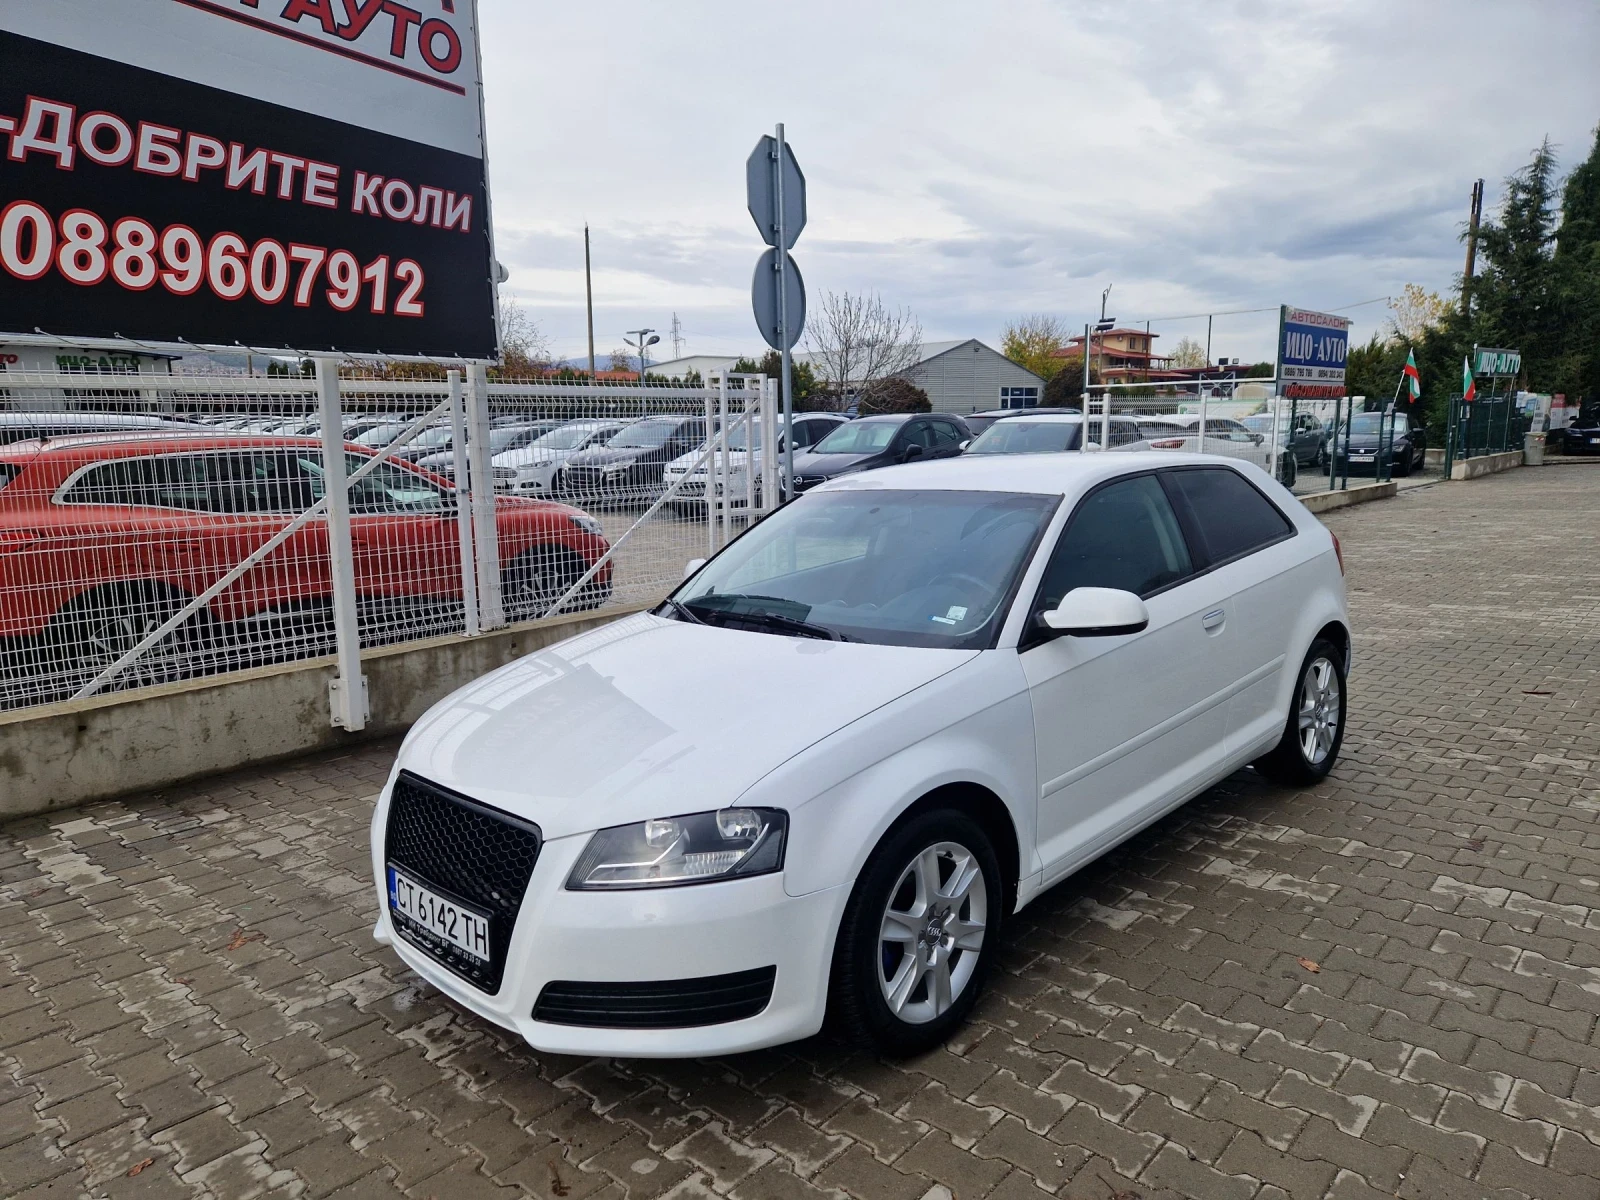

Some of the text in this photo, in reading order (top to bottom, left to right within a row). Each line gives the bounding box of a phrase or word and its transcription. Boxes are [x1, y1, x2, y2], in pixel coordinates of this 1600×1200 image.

[351, 170, 473, 233] КОЛИ
[0, 200, 425, 317] 0889607912
[1290, 311, 1346, 328] АВТОСАЛОН
[56, 354, 141, 366] ИЦО-АУТО
[1286, 332, 1345, 363] ИЦО-АУТО
[397, 878, 414, 914] CT
[418, 892, 458, 941] 6142
[461, 913, 488, 955] TH
